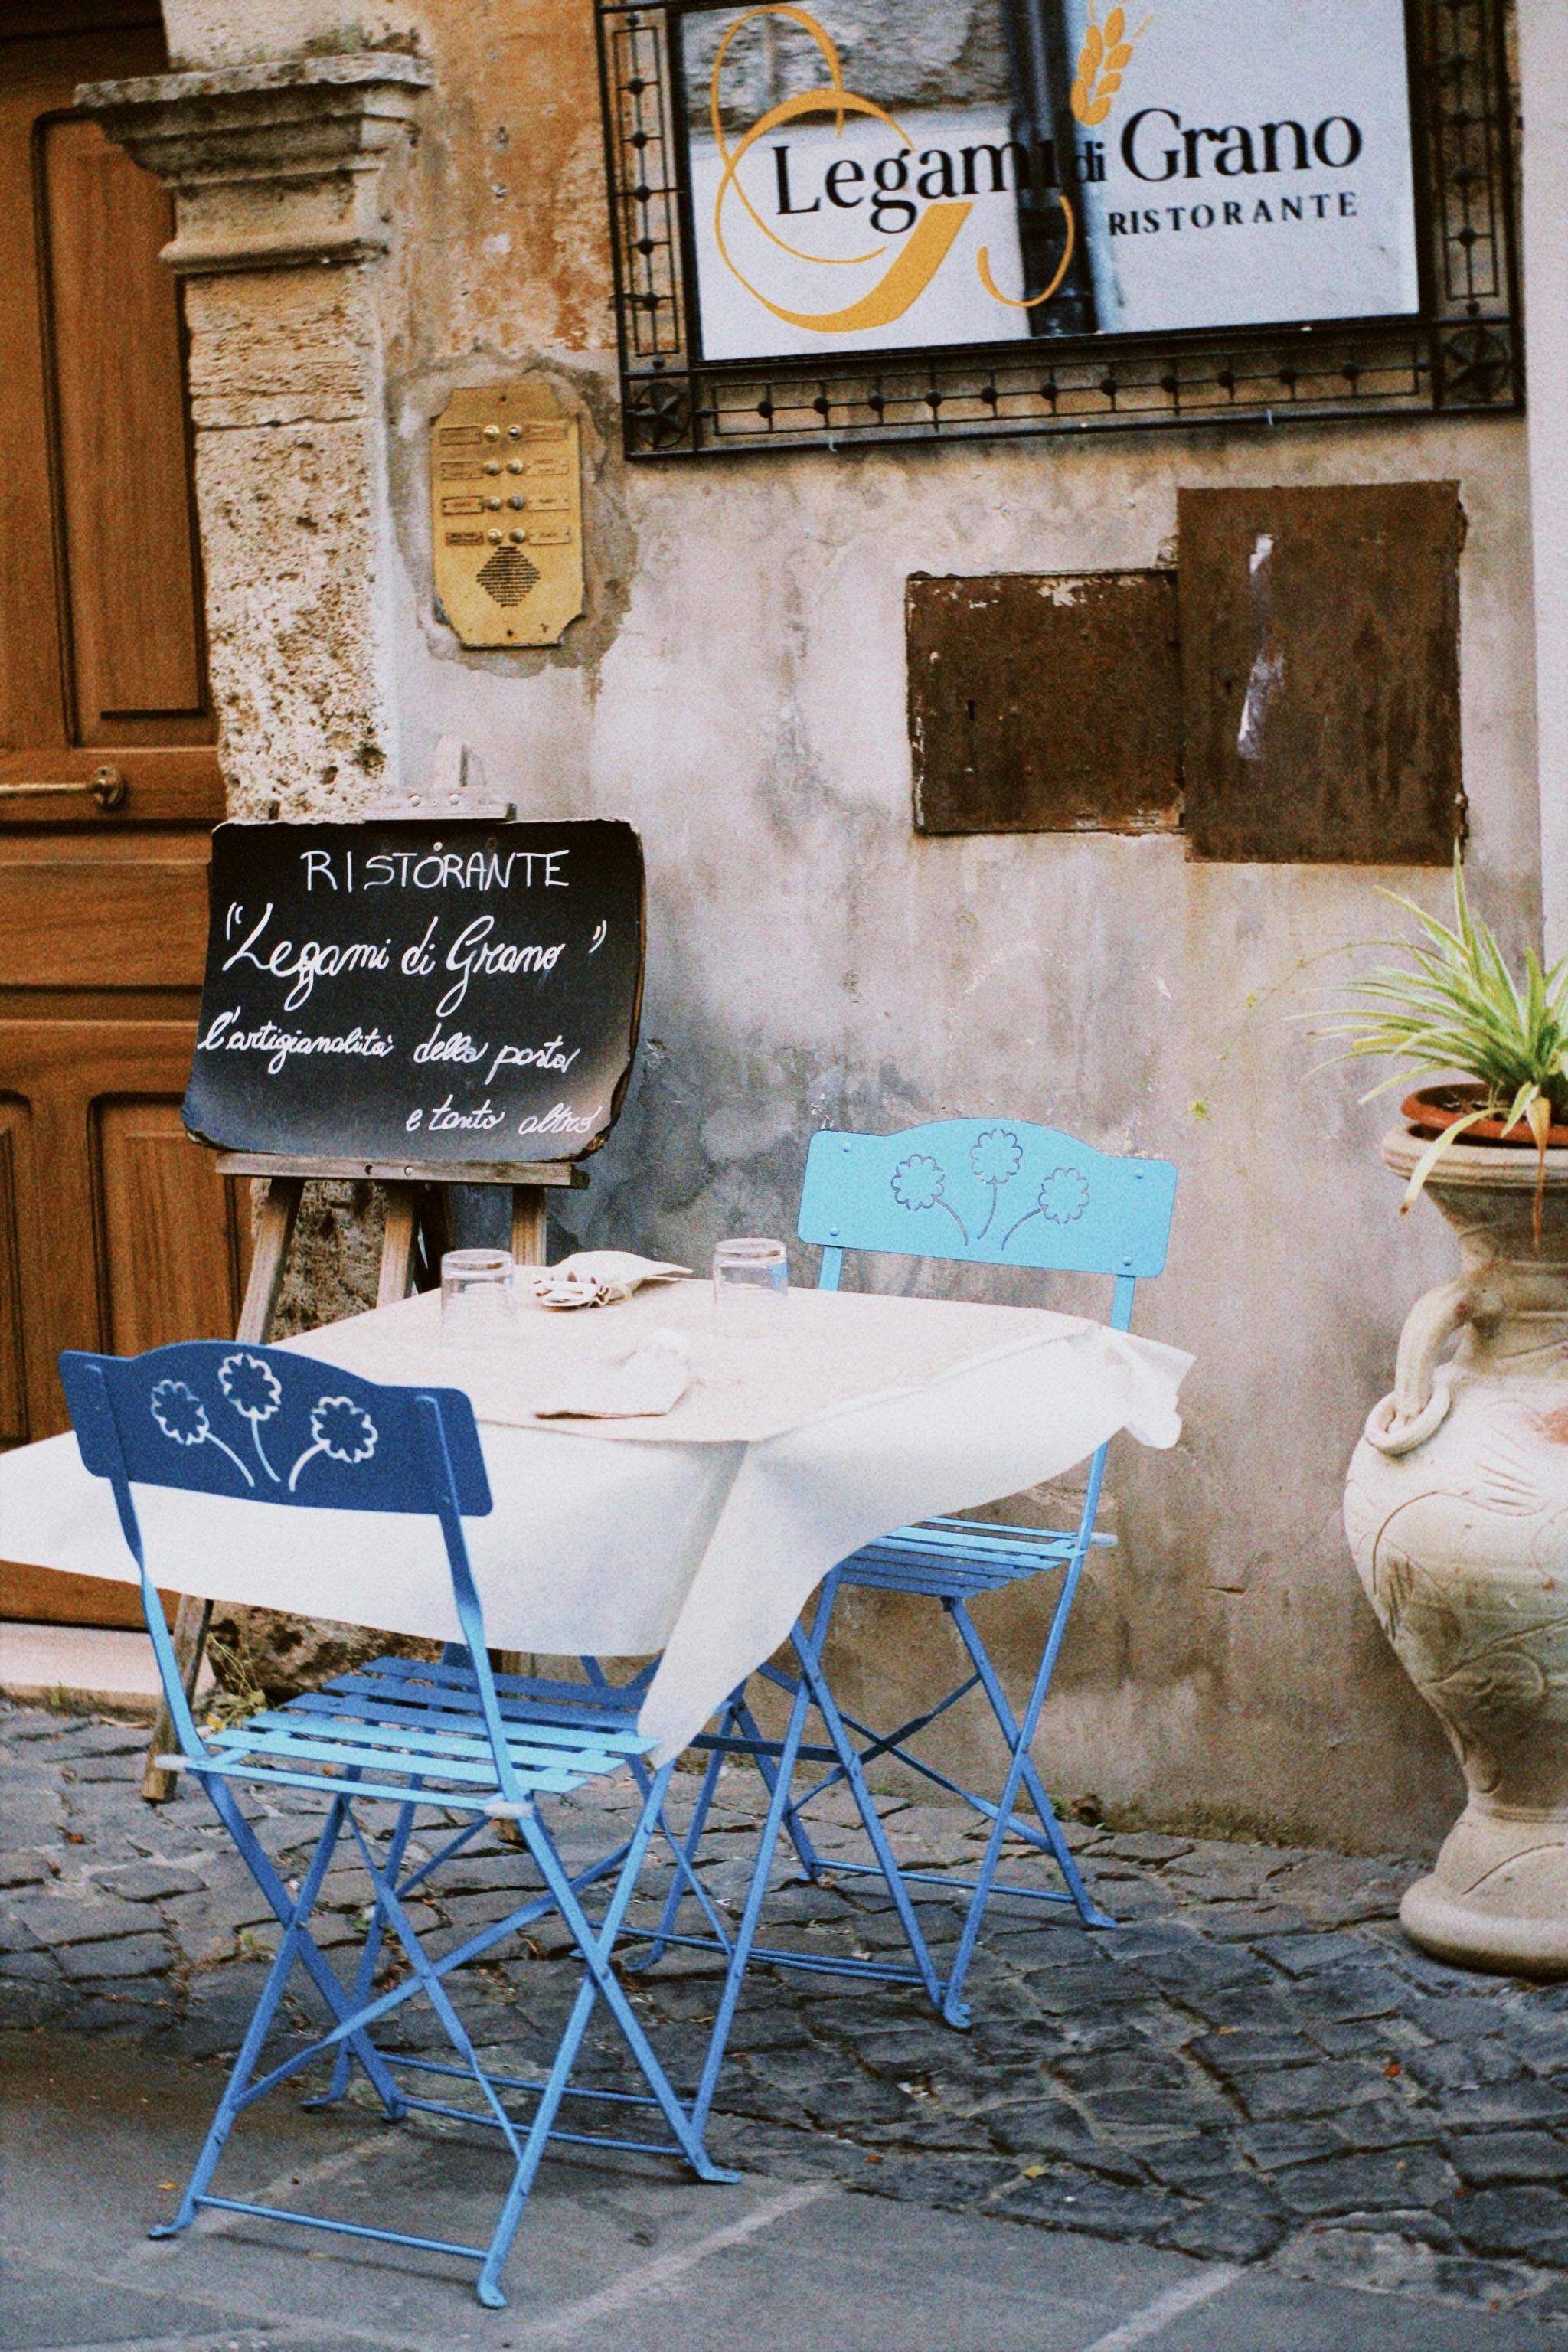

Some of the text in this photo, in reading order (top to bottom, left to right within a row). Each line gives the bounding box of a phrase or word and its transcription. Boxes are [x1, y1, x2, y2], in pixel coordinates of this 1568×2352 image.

[772, 138, 1057, 235] Legami
[1120, 108, 1363, 183] Grano
[1108, 191, 1358, 237] RISTORANTE
[299, 848, 570, 893] RISTORANTE
[401, 916, 438, 975] di
[413, 1022, 489, 1064] della
[485, 1035, 582, 1086] pasta
[406, 1094, 603, 1136] e tanto altro
